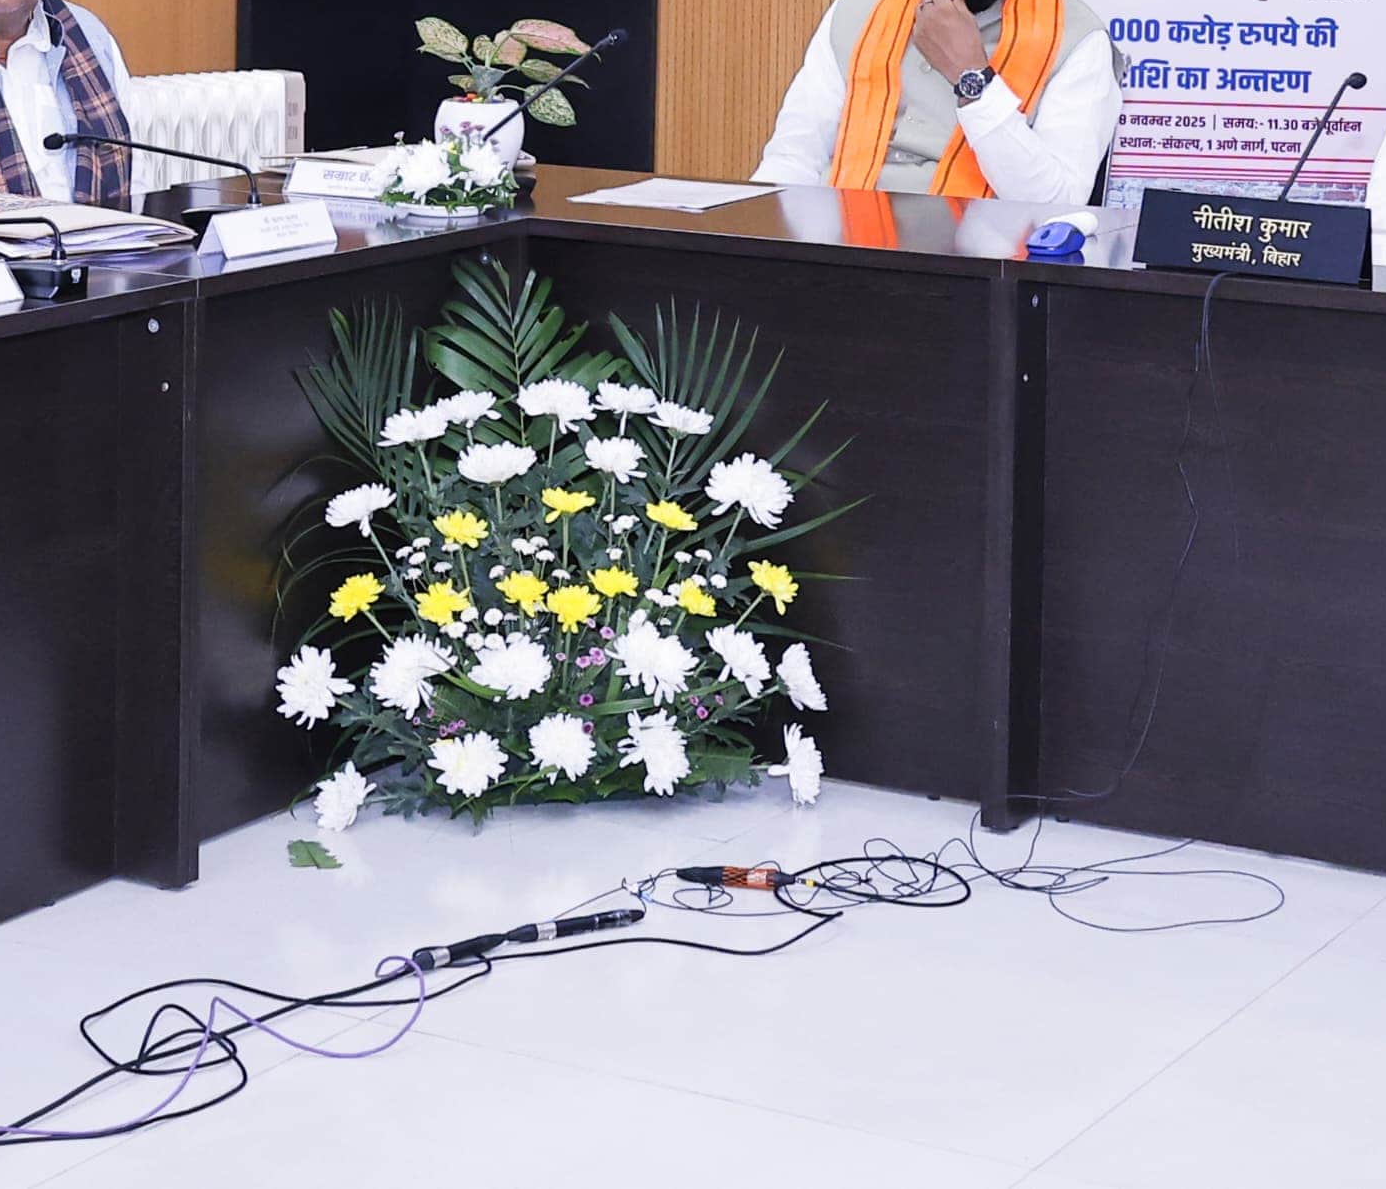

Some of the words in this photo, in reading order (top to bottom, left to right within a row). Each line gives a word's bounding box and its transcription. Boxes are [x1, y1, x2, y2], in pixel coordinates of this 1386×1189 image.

[1111, 18, 1159, 44] 000
[1166, 15, 1233, 51] करोड़
[1237, 17, 1300, 46] रुपये
[1304, 17, 1339, 47] की
[1175, 67, 1210, 90] का
[1216, 68, 1312, 93] अन्तरण
[1119, 114, 1126, 124] 8
[1130, 115, 1172, 126] नवम्बर
[1175, 116, 1205, 127] 2025
[1268, 119, 1298, 130] 11.30
[1207, 139, 1212, 150] 1
[1216, 137, 1238, 151] अणे
[1241, 138, 1267, 153] मार्ग,
[1271, 142, 1301, 153] पटना
[1193, 204, 1254, 233] नीतीश
[1258, 216, 1311, 241] कुमार
[1192, 241, 1255, 265] मुख्यमंत्री,
[1262, 246, 1301, 267] बिहार
